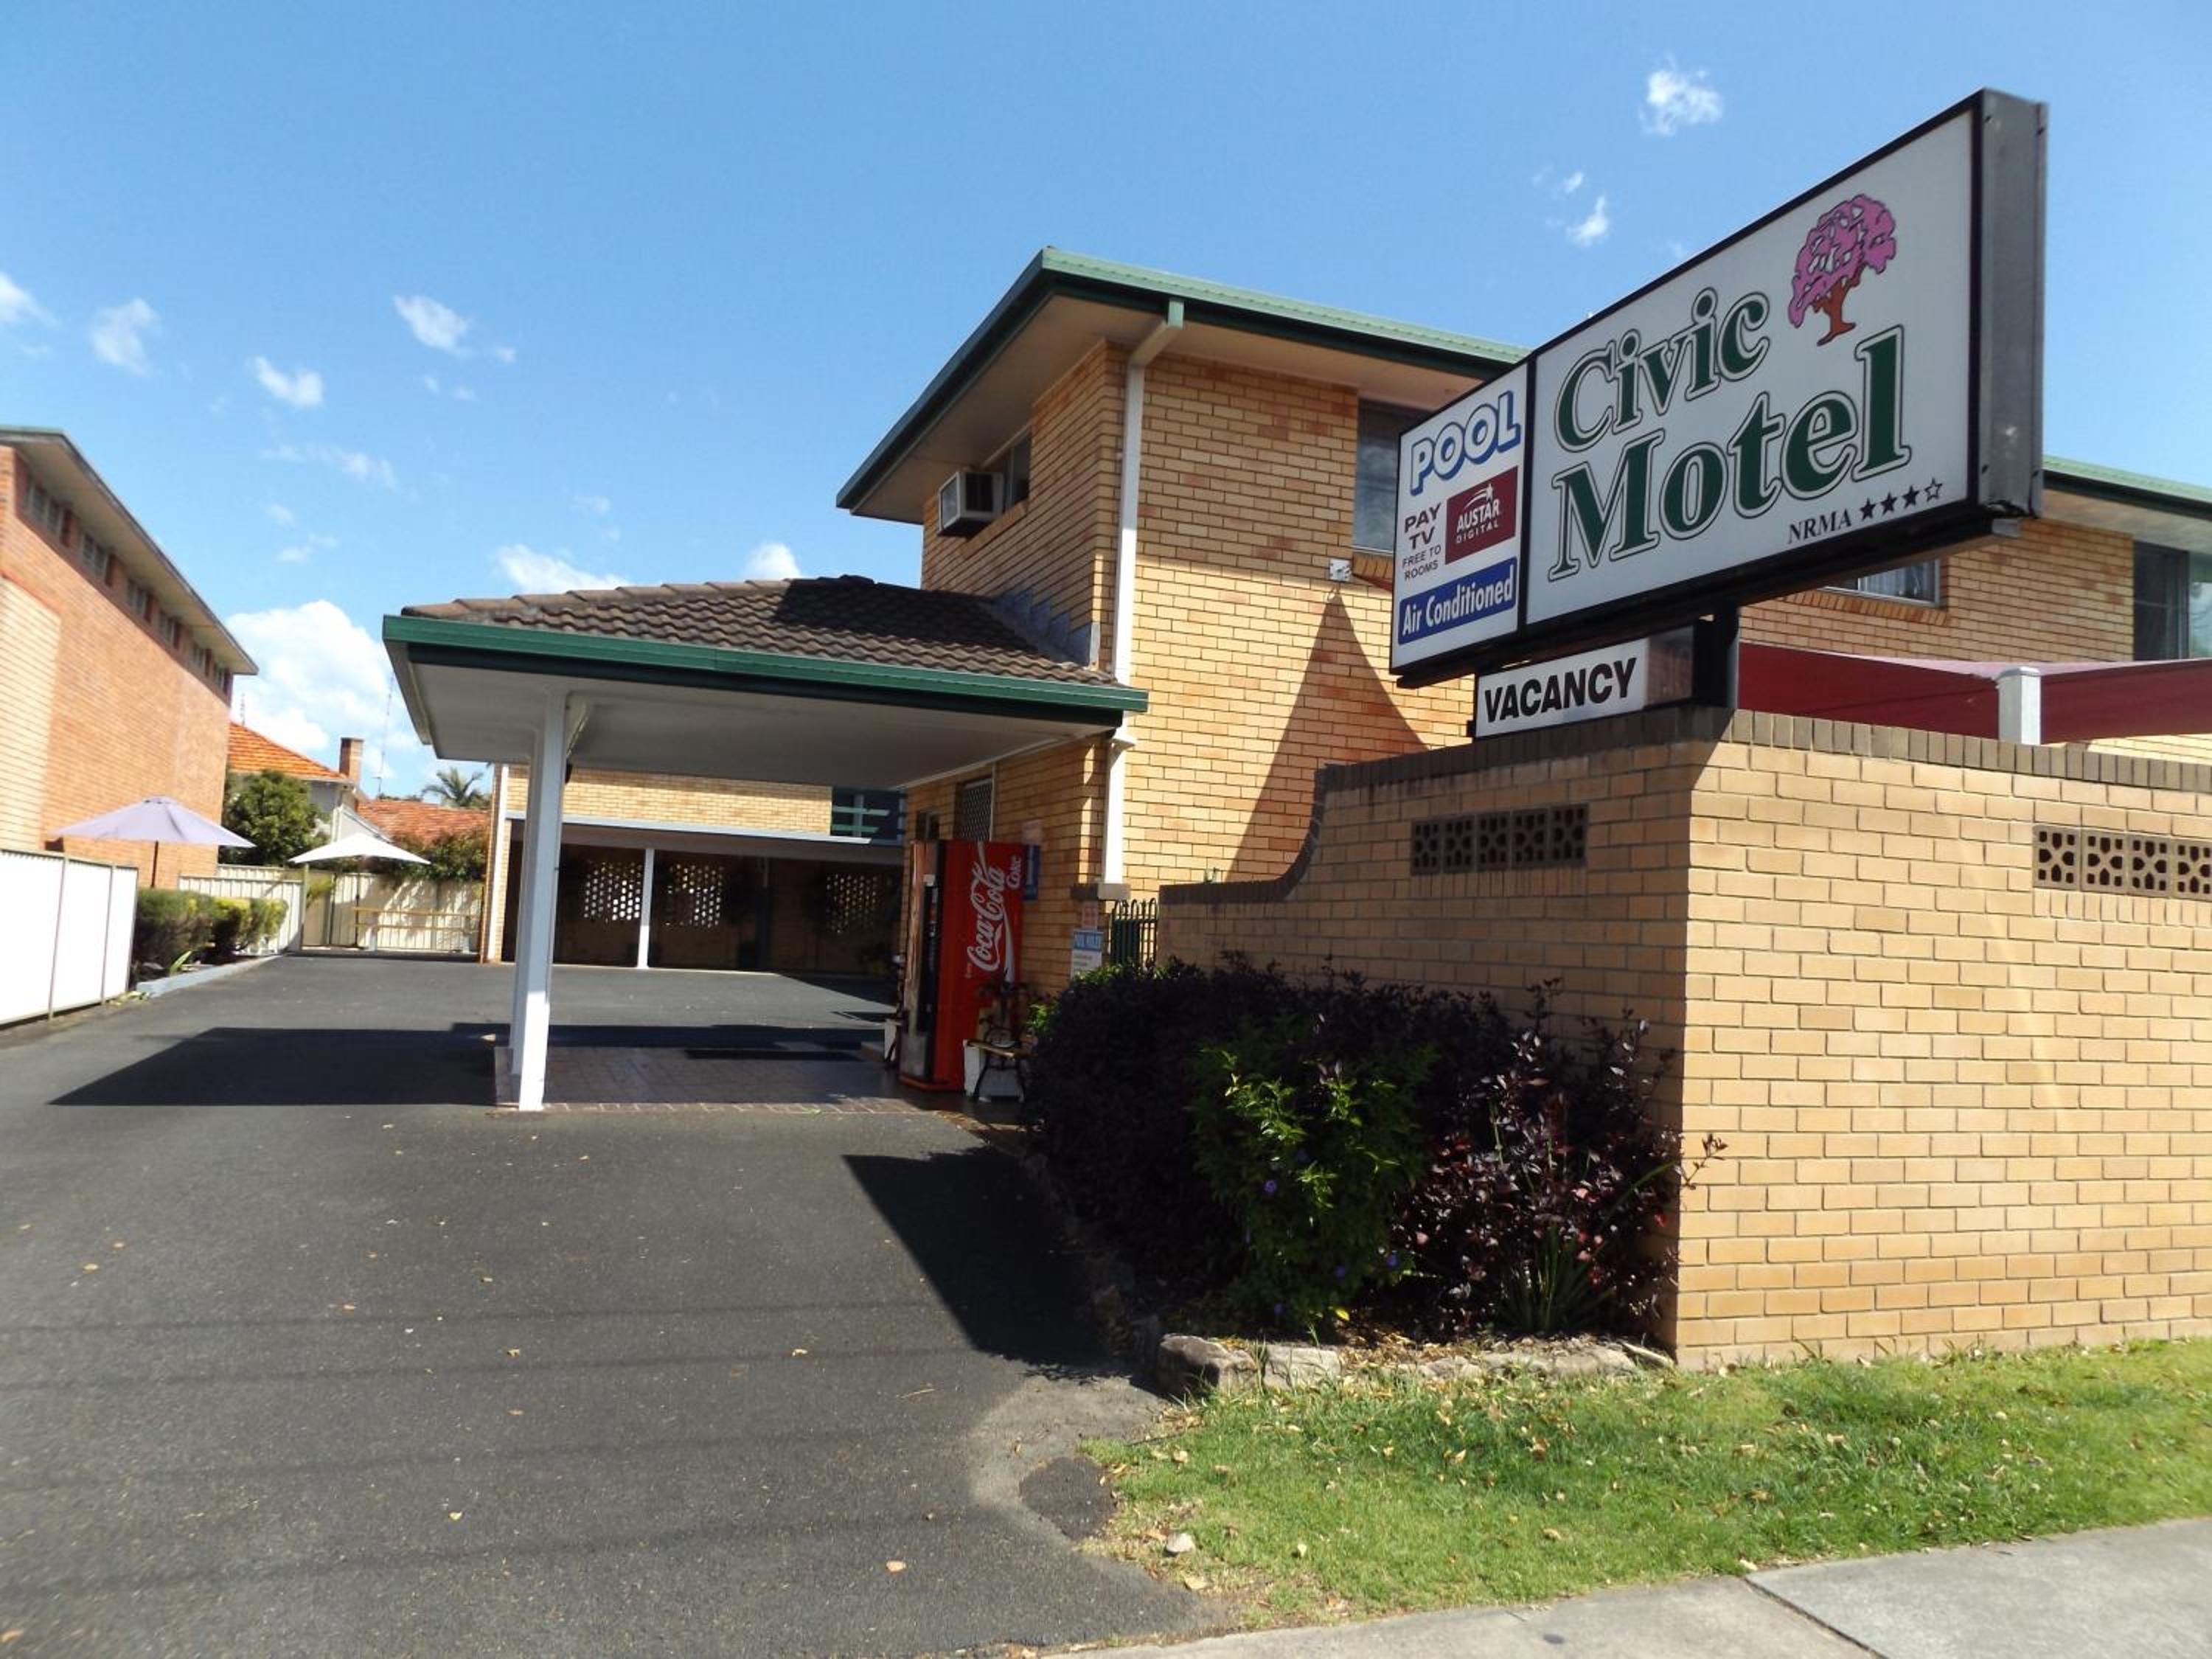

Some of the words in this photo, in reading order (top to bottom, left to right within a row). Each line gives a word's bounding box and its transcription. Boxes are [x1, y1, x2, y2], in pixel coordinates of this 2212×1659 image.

[1555, 287, 1770, 453] Civic
[1411, 391, 1520, 495] POOL
[1549, 324, 1911, 582] Motel
[1404, 503, 1441, 533] PAY
[1455, 519, 1499, 544] DIGITAL
[1456, 498, 1500, 534] AUSTAR
[1787, 508, 1852, 544] NRMA
[1409, 526, 1436, 549] TV
[1402, 552, 1425, 568] FREE
[1429, 545, 1441, 557] TO
[1404, 560, 1439, 580] ROOMS
[1402, 604, 1422, 636] Air
[1426, 565, 1514, 627] Conditioned
[1484, 658, 1637, 723] VACANCY
